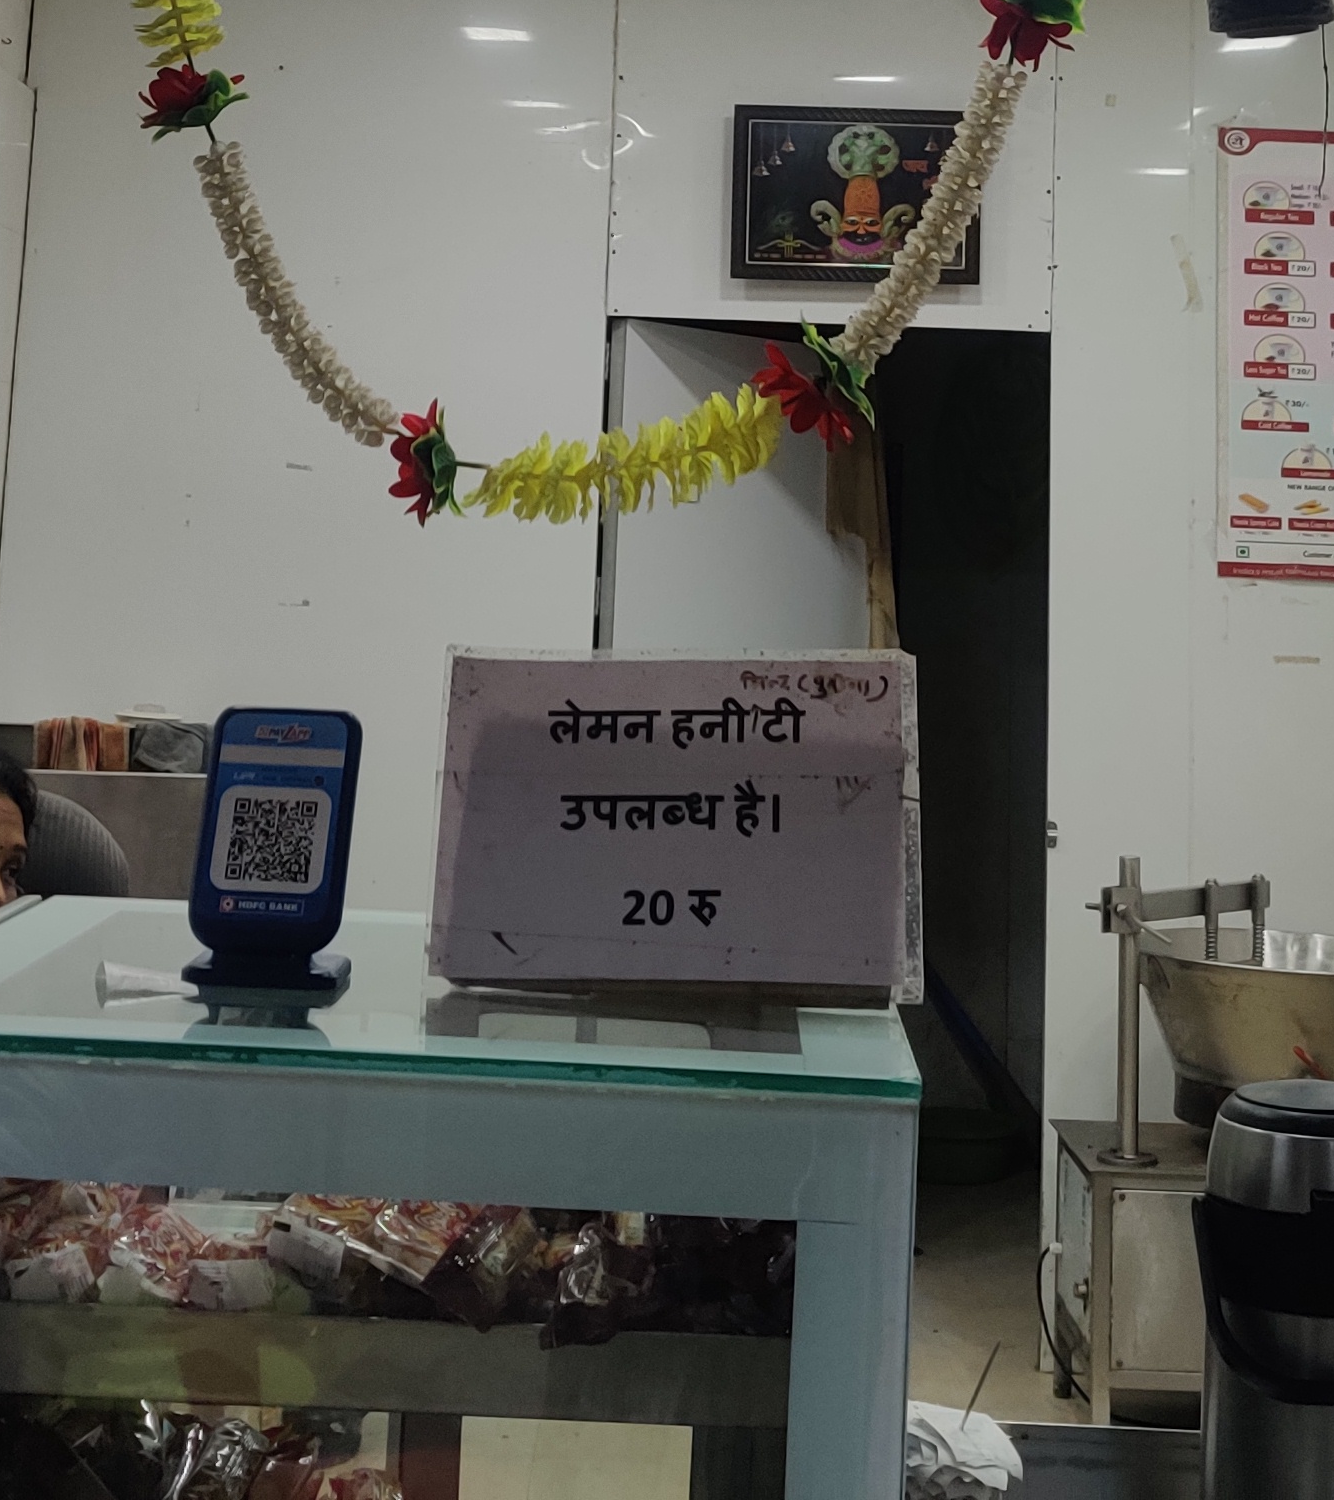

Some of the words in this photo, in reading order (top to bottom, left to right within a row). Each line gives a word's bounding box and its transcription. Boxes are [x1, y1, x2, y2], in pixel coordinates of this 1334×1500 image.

[549, 700, 661, 744] लेमन
[671, 697, 751, 749] हनी
[762, 697, 806, 744] टी
[560, 793, 724, 831] उपलब्ध
[622, 889, 675, 927] 20
[688, 889, 722, 927] रु
